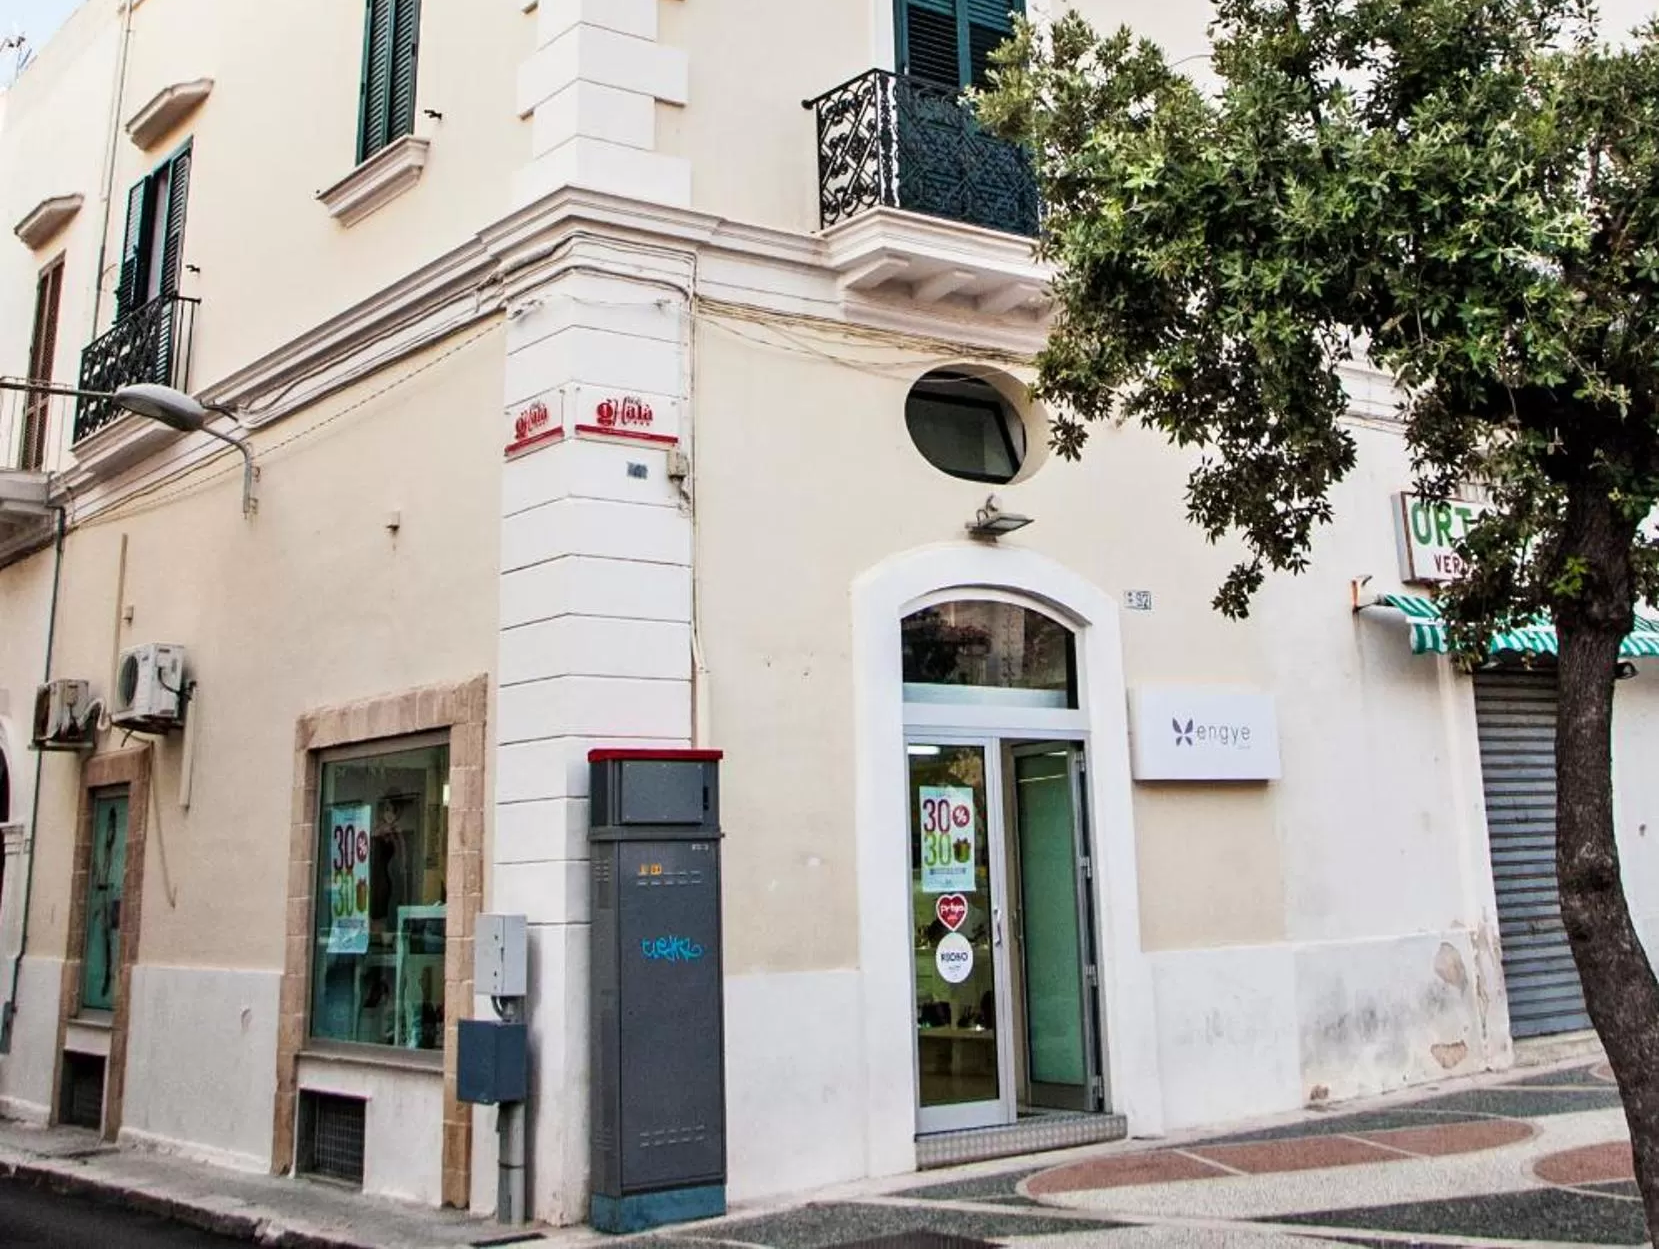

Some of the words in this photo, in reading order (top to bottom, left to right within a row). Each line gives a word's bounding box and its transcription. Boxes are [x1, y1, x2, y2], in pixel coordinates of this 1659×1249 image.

[1411, 501, 1472, 548] ORT
[1196, 724, 1251, 746] engye
[924, 833, 952, 867] 30
